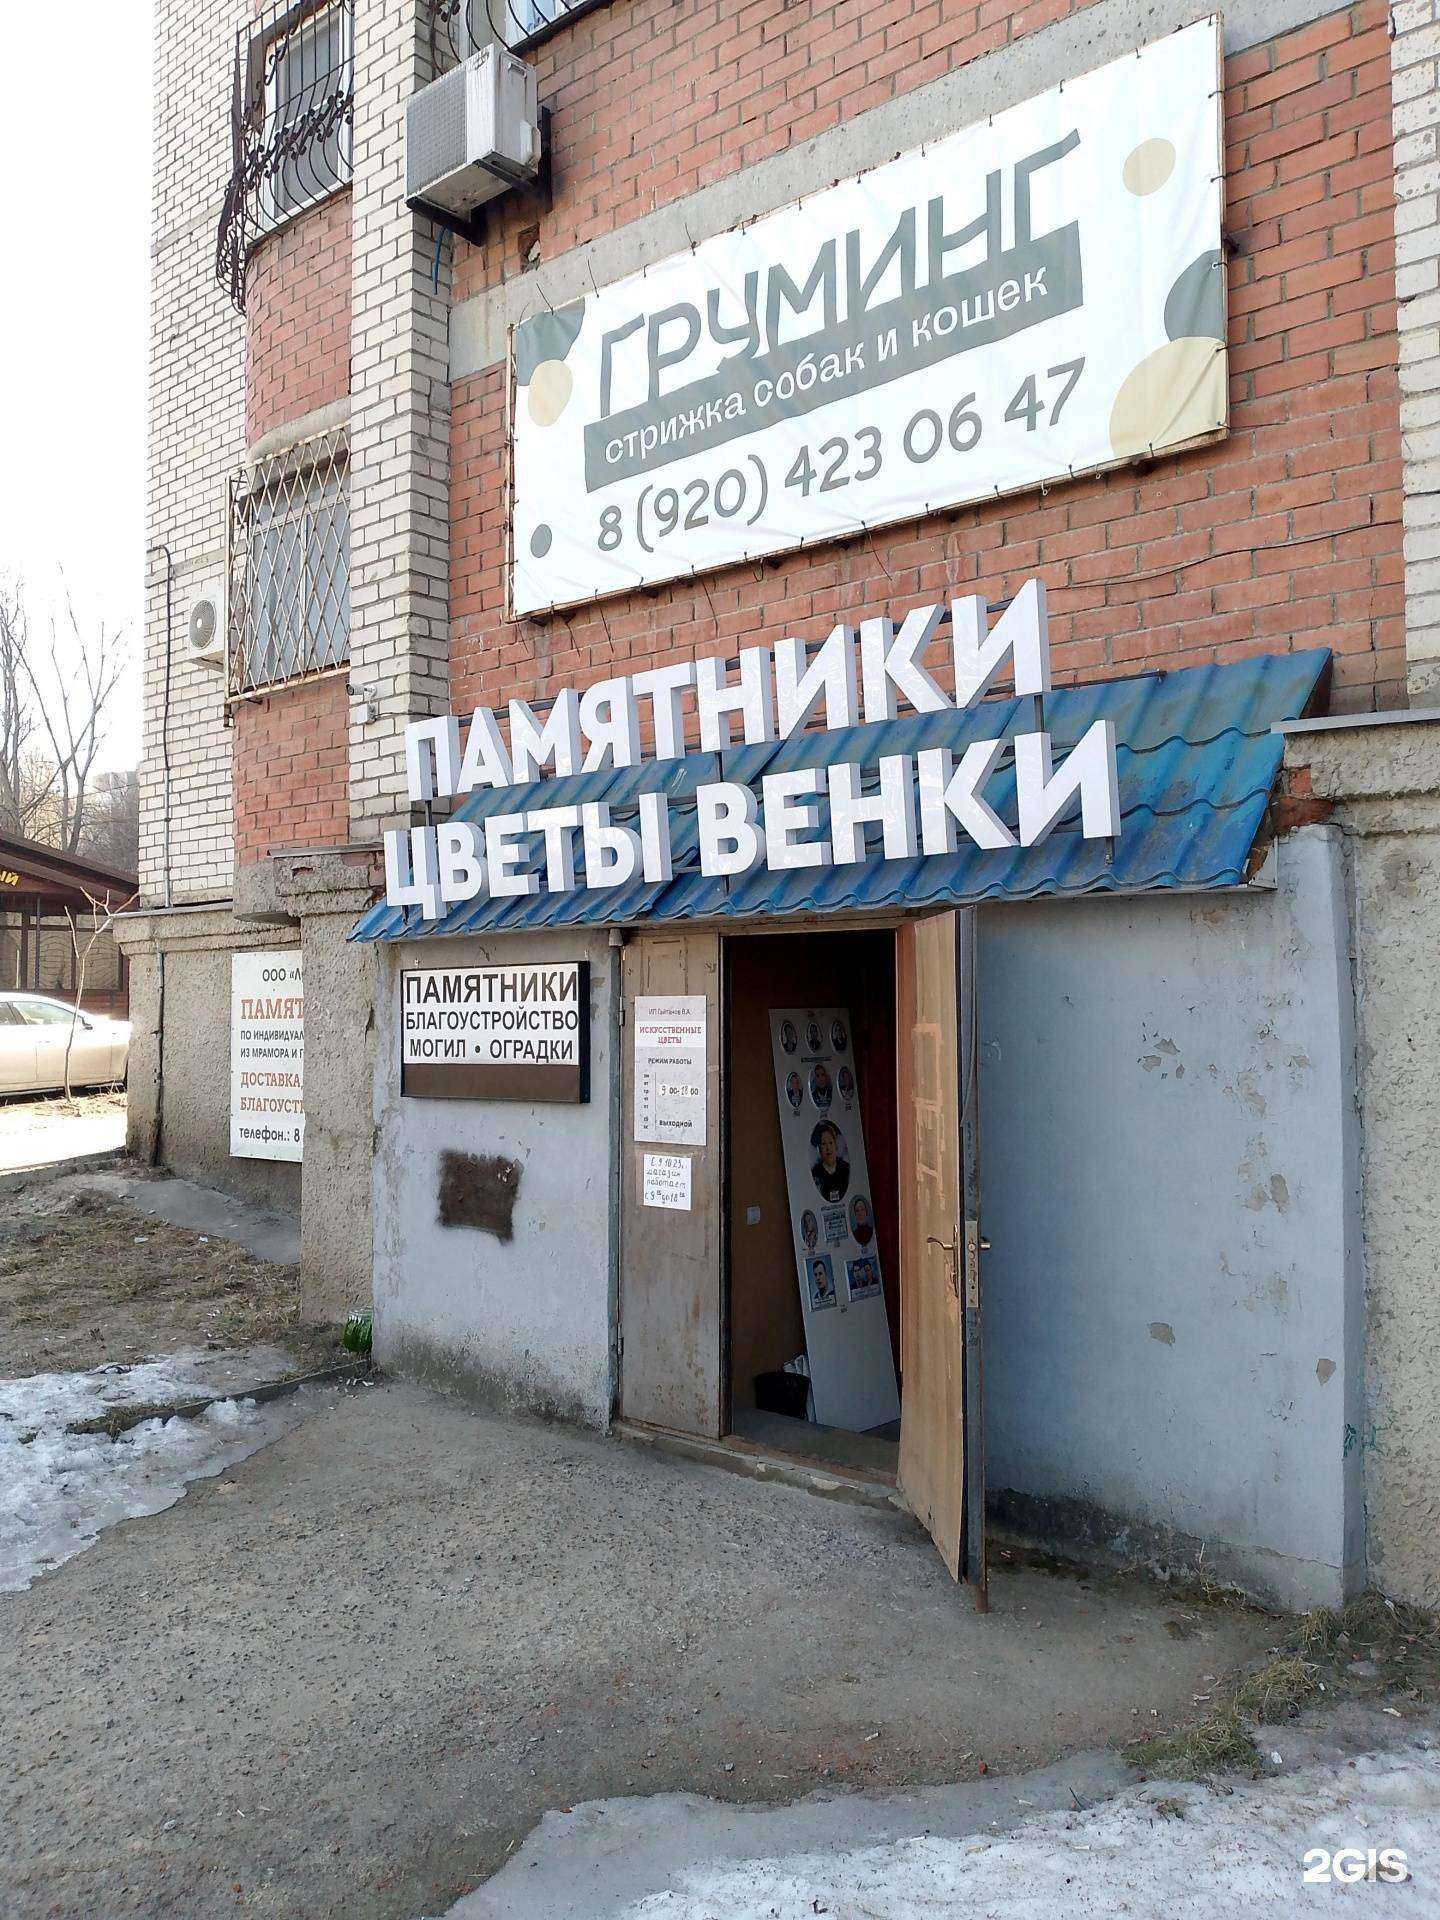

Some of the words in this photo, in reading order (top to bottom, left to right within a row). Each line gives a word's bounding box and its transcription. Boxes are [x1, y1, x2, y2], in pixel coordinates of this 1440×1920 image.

[600, 128, 1081, 418] ГРУМИНГ
[604, 392, 747, 465] стрижка
[754, 341, 866, 408] собак
[877, 332, 900, 362] и
[912, 265, 1048, 349] кошек
[784, 425, 882, 500] 423
[903, 391, 983, 465] 06
[1005, 356, 1086, 433] 47
[405, 577, 1051, 802] ПАМЯТНИКИ
[383, 792, 673, 920] ЦВЕТЫ
[696, 720, 1121, 878] ВЕНКИ
[262, 967, 287, 982] ООО
[405, 971, 577, 1004] ПАМЯТНИКИ
[406, 1006, 579, 1031] БЛАГОУСТРОЙСТВО
[639, 1026, 702, 1034] ИСКУССТВЕННЫЕ
[240, 1030, 251, 1041] ПО
[658, 1036, 682, 1044] ЦВЕТЫ
[240, 1047, 250, 1059] ИЗ
[252, 1047, 290, 1059] МРАМОРА
[291, 1048, 298, 1059] И
[410, 1038, 466, 1058] МОГИЛ
[489, 1039, 573, 1063] ОГРАДКИ
[293, 1127, 300, 1143] 8
